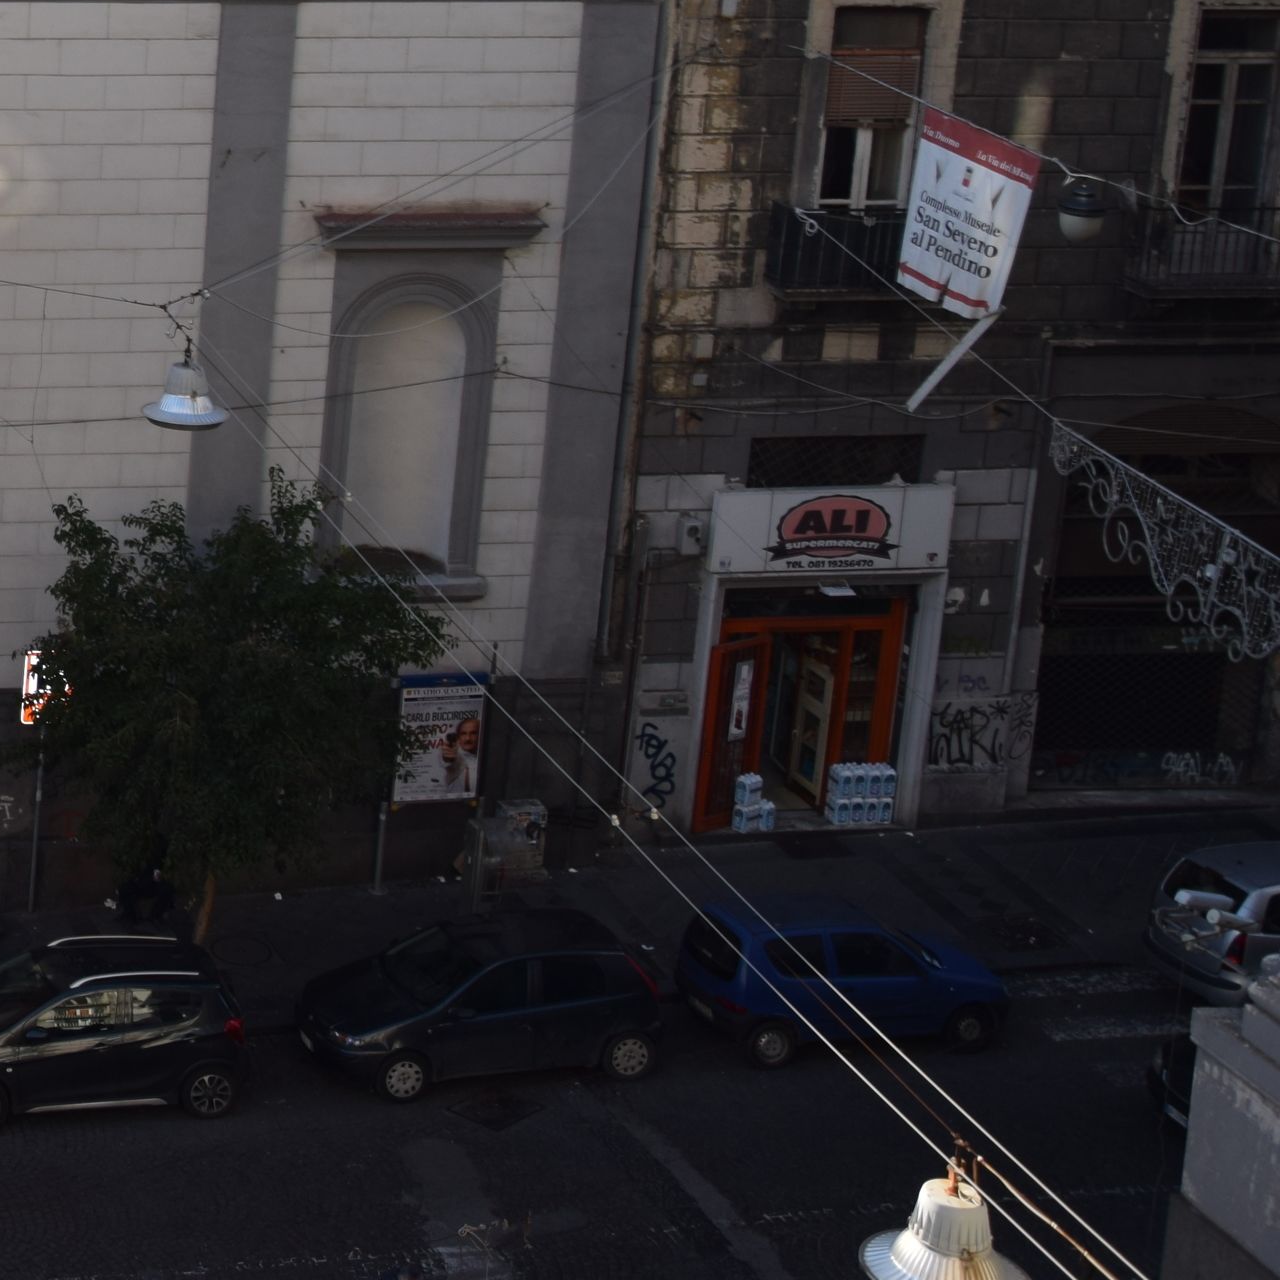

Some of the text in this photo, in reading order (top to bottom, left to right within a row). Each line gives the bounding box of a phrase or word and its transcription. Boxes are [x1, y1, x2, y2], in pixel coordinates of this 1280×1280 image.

[914, 205, 999, 259] San Severo
[920, 190, 962, 220] Complesso
[963, 209, 1001, 238] Museale
[910, 229, 992, 280] al Pendino
[793, 509, 872, 535] ALI
[406, 712, 430, 722] CARLO
